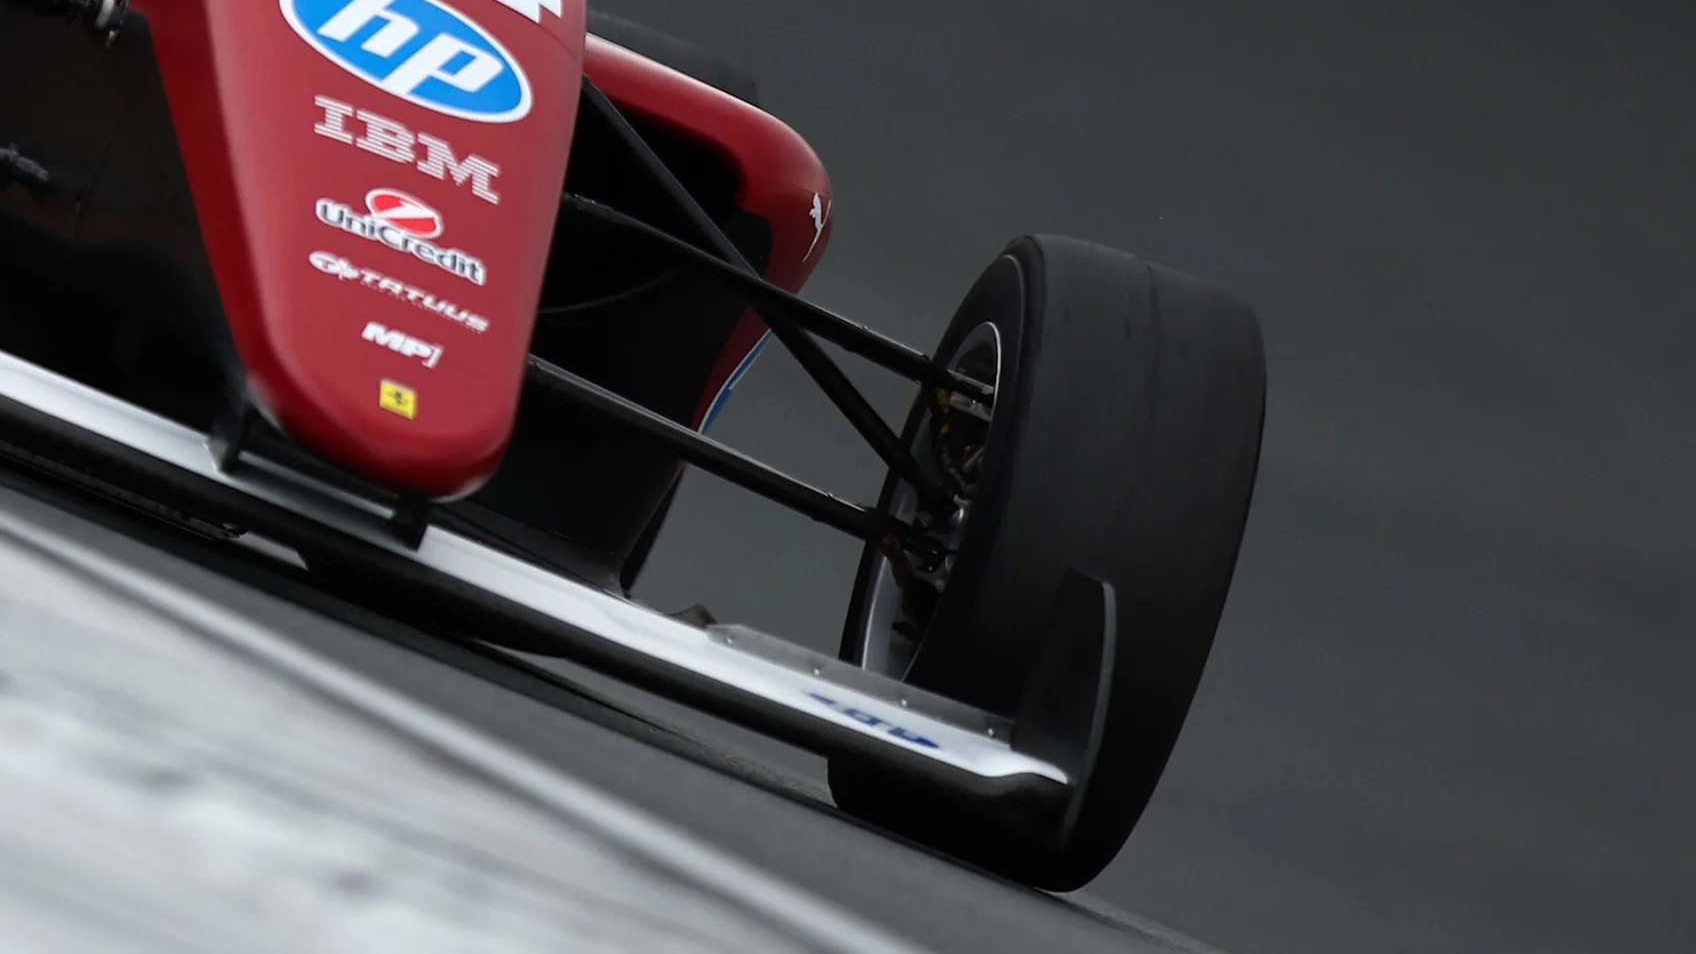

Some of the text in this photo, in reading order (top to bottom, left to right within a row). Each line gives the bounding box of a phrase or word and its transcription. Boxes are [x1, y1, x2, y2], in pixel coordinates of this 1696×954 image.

[313, 95, 501, 205] IBM
[318, 200, 485, 285] UniCredit
[360, 269, 490, 333] TATUUS
